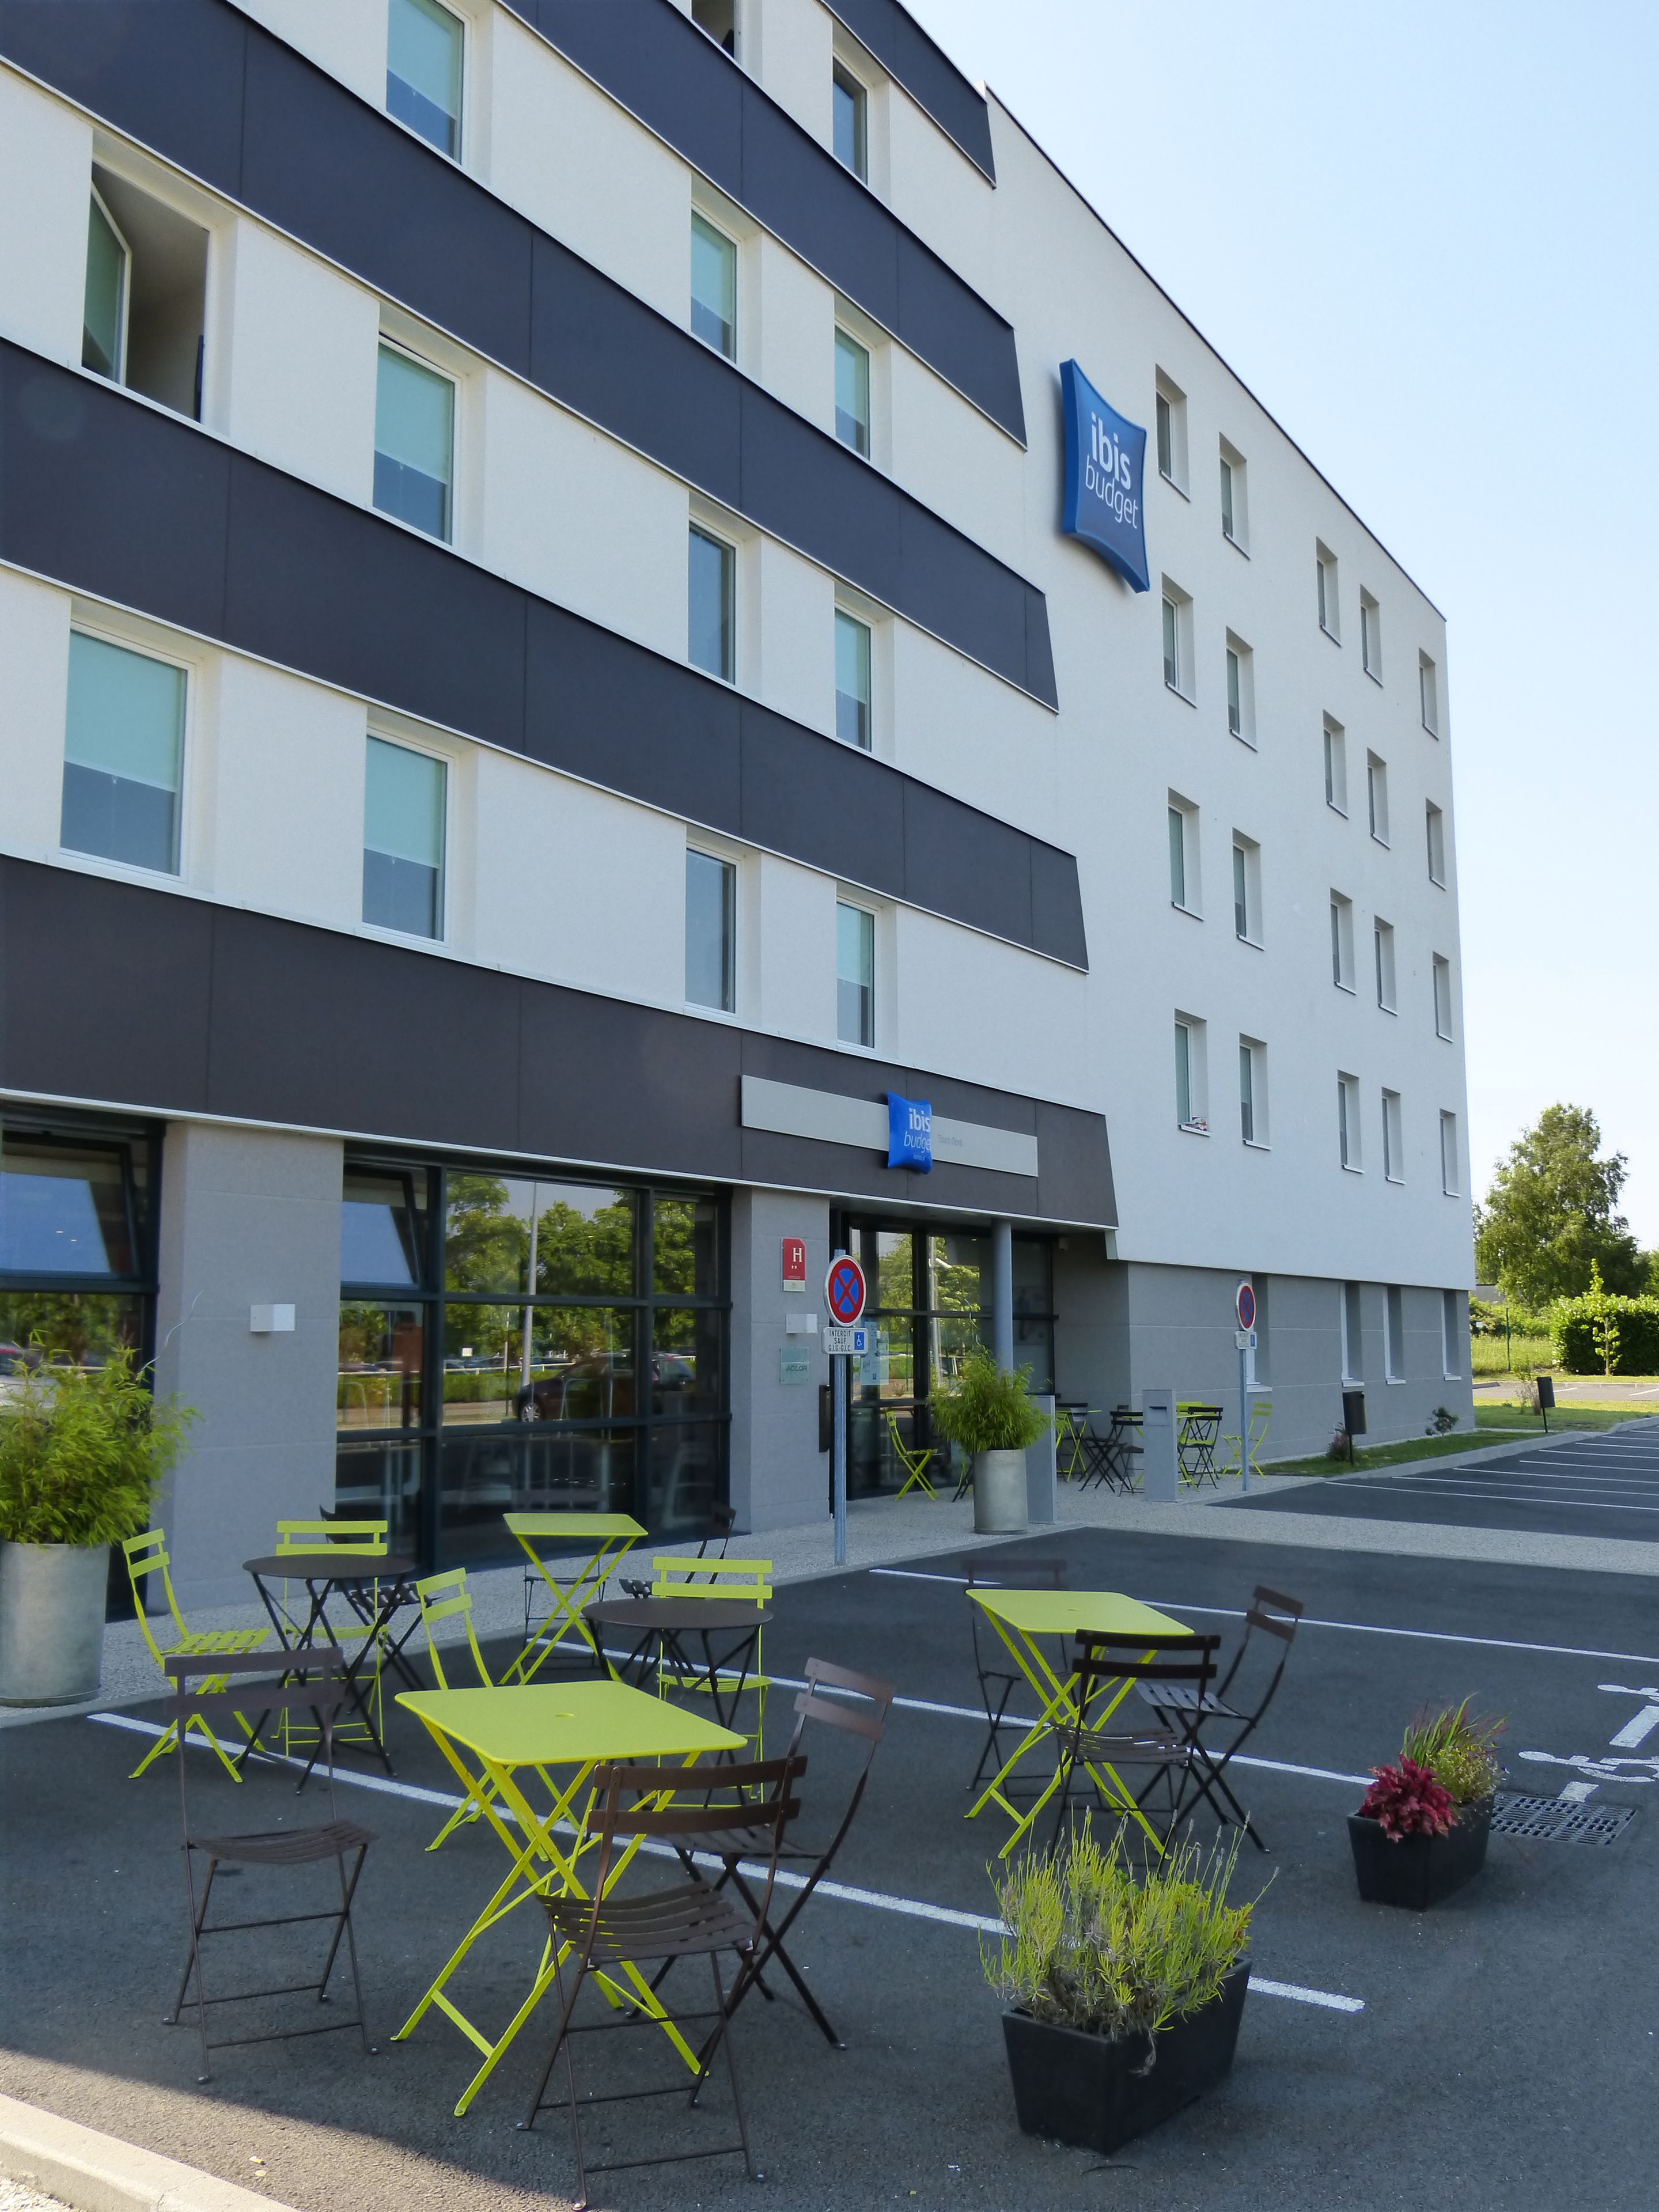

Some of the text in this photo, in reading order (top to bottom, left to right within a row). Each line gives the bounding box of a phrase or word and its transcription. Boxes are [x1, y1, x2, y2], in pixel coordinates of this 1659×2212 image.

[1090, 411, 1131, 490] ibis
[1085, 454, 1138, 529] budget
[908, 1107, 931, 1132] ibis
[793, 1247, 802, 1262] H
